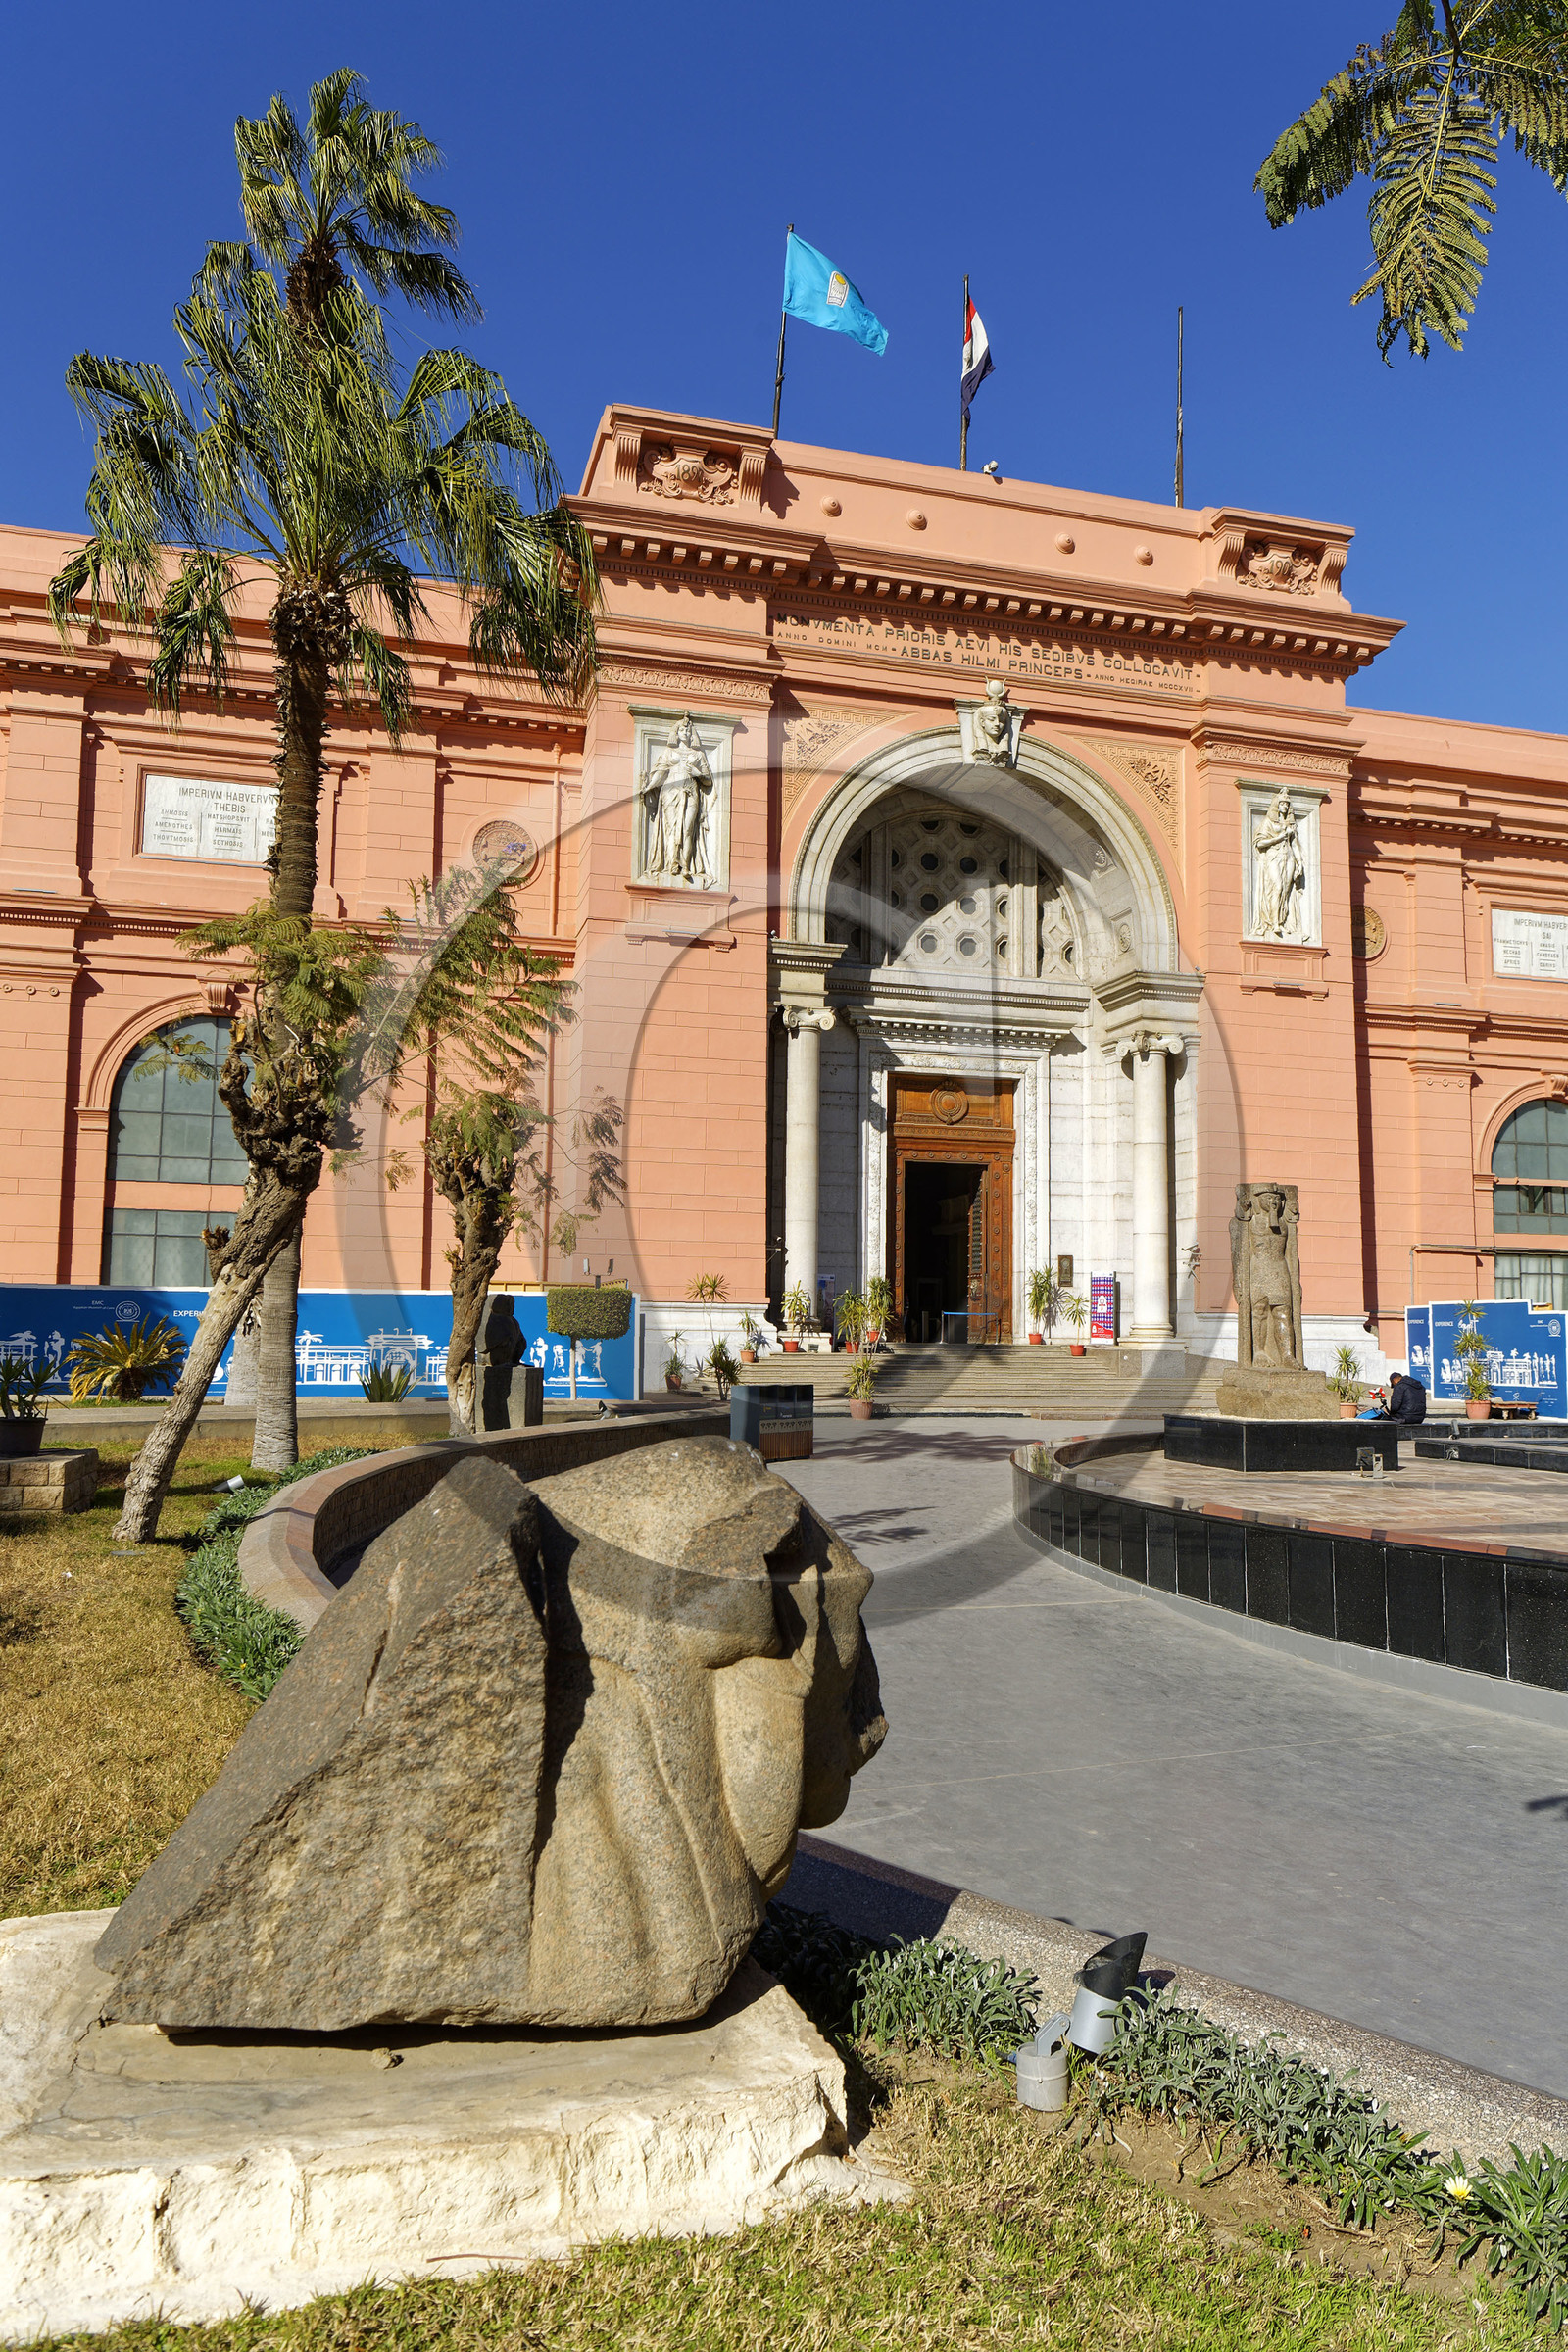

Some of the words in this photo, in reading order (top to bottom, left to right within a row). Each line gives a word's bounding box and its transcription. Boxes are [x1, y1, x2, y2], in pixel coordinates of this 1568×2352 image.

[777, 612, 875, 637] MONVMENTA
[885, 628, 946, 646] PRIORIS
[956, 637, 990, 653] AEVI
[999, 643, 1022, 657] HIS
[1031, 648, 1096, 666] SEDIBVS
[1103, 658, 1193, 680] COLLOCAVIT
[777, 631, 808, 641] ANNO
[818, 637, 857, 648] DOMINI
[866, 643, 888, 653] MCM
[901, 646, 953, 662] ABBAS
[961, 654, 1000, 669] HILMI
[1008, 660, 1083, 679] PRINCEPS
[1094, 673, 1115, 682] ANNO
[1119, 677, 1153, 687] HEGIRAE
[179, 787, 222, 800] IMPERIVM
[226, 792, 278, 805] HABVERVN
[214, 802, 246, 813] THEBIS
[155, 821, 193, 830] AMENOTHES
[213, 839, 244, 848] SETHOSIS
